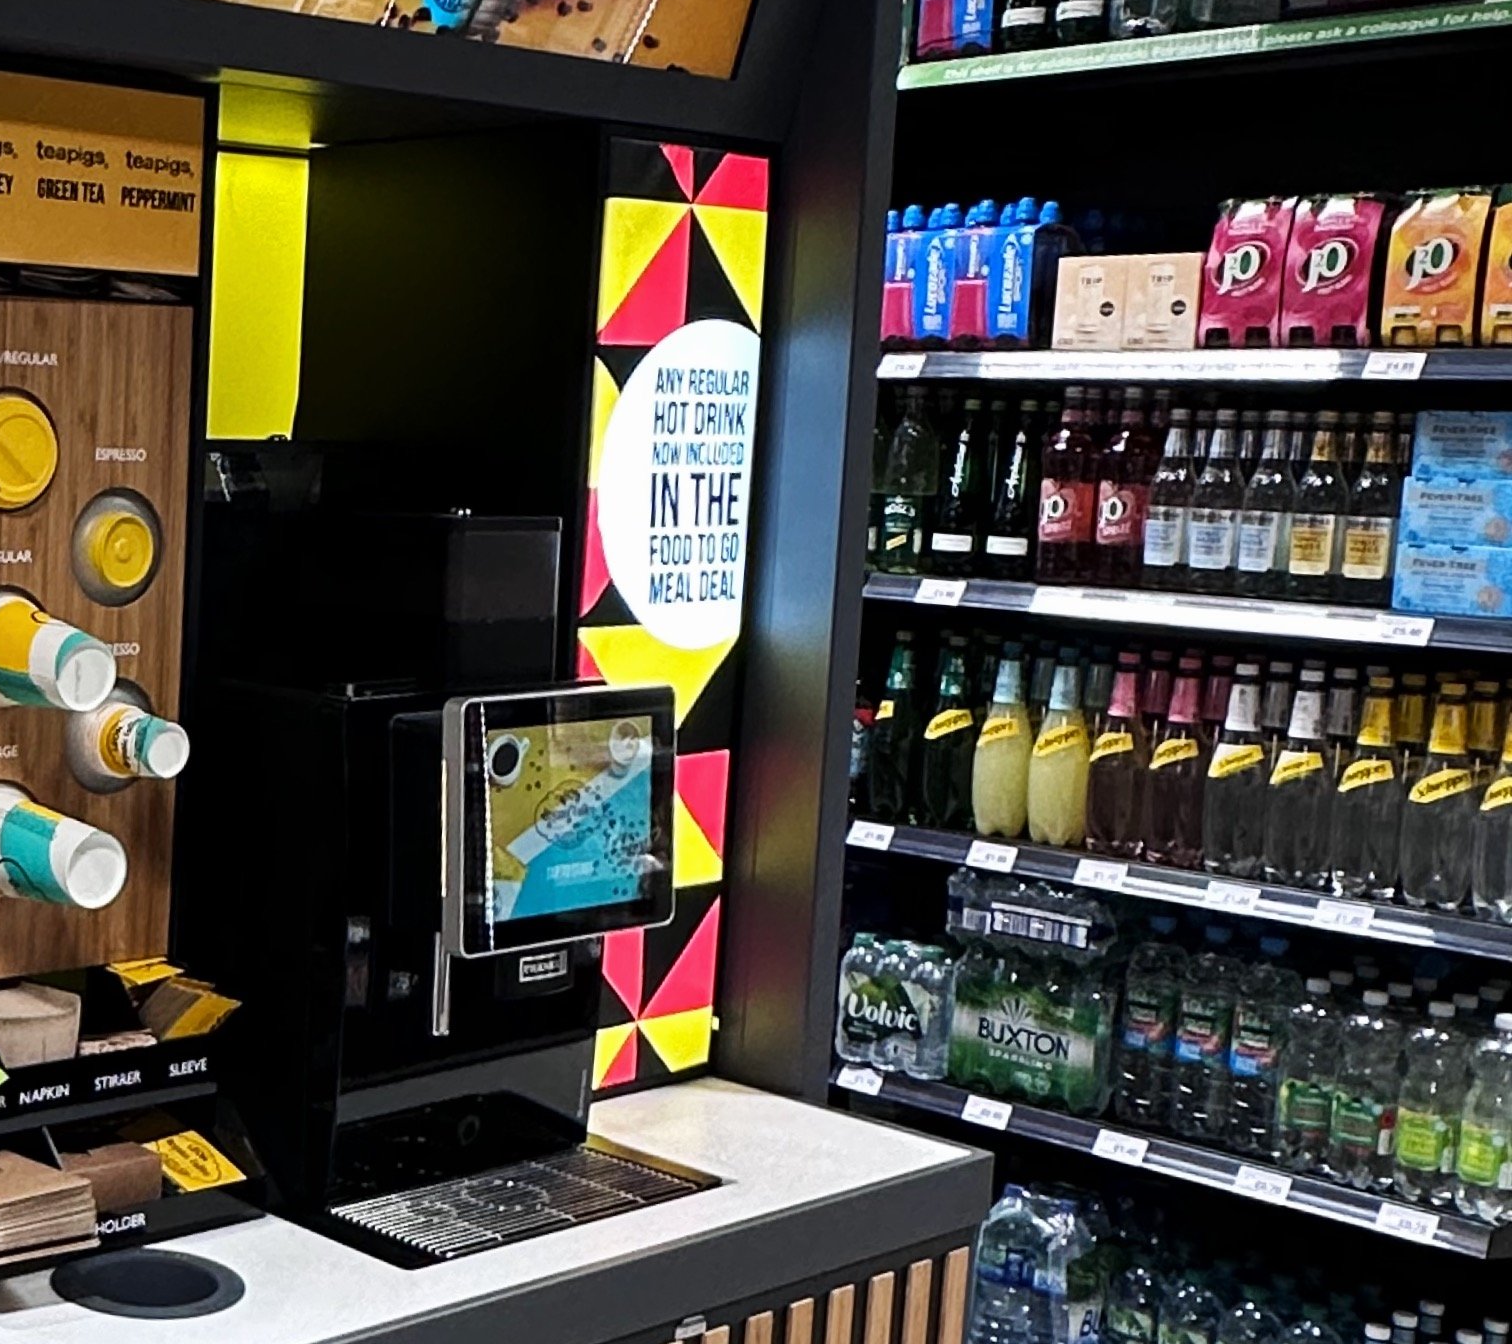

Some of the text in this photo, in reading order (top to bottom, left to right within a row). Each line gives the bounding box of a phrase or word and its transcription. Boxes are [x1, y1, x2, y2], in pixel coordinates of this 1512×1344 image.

[1262, 30, 1313, 48] please
[1315, 26, 1343, 40] ask
[1359, 15, 1439, 38] colleague
[1442, 11, 1468, 25] for
[37, 177, 106, 206] GREEN TEA
[120, 186, 197, 213] PEPPERMINT
[654, 366, 750, 398] ANY REGULAR
[653, 401, 747, 436] HOT DRINK
[94, 447, 148, 463] ESPRESSO
[652, 441, 745, 466] NOW INCLUDED
[649, 471, 741, 529] IN THE
[649, 531, 740, 567] FOOD TO GO
[648, 570, 736, 605] MEAL DEAL
[847, 992, 920, 1031] Volvic
[977, 1016, 1070, 1061] BUXTON
[93, 1069, 142, 1093] STIRRER
[168, 1057, 209, 1078] SLEEVE
[18, 1082, 71, 1106] NAPKIN
[94, 1212, 146, 1236] HOLDER
